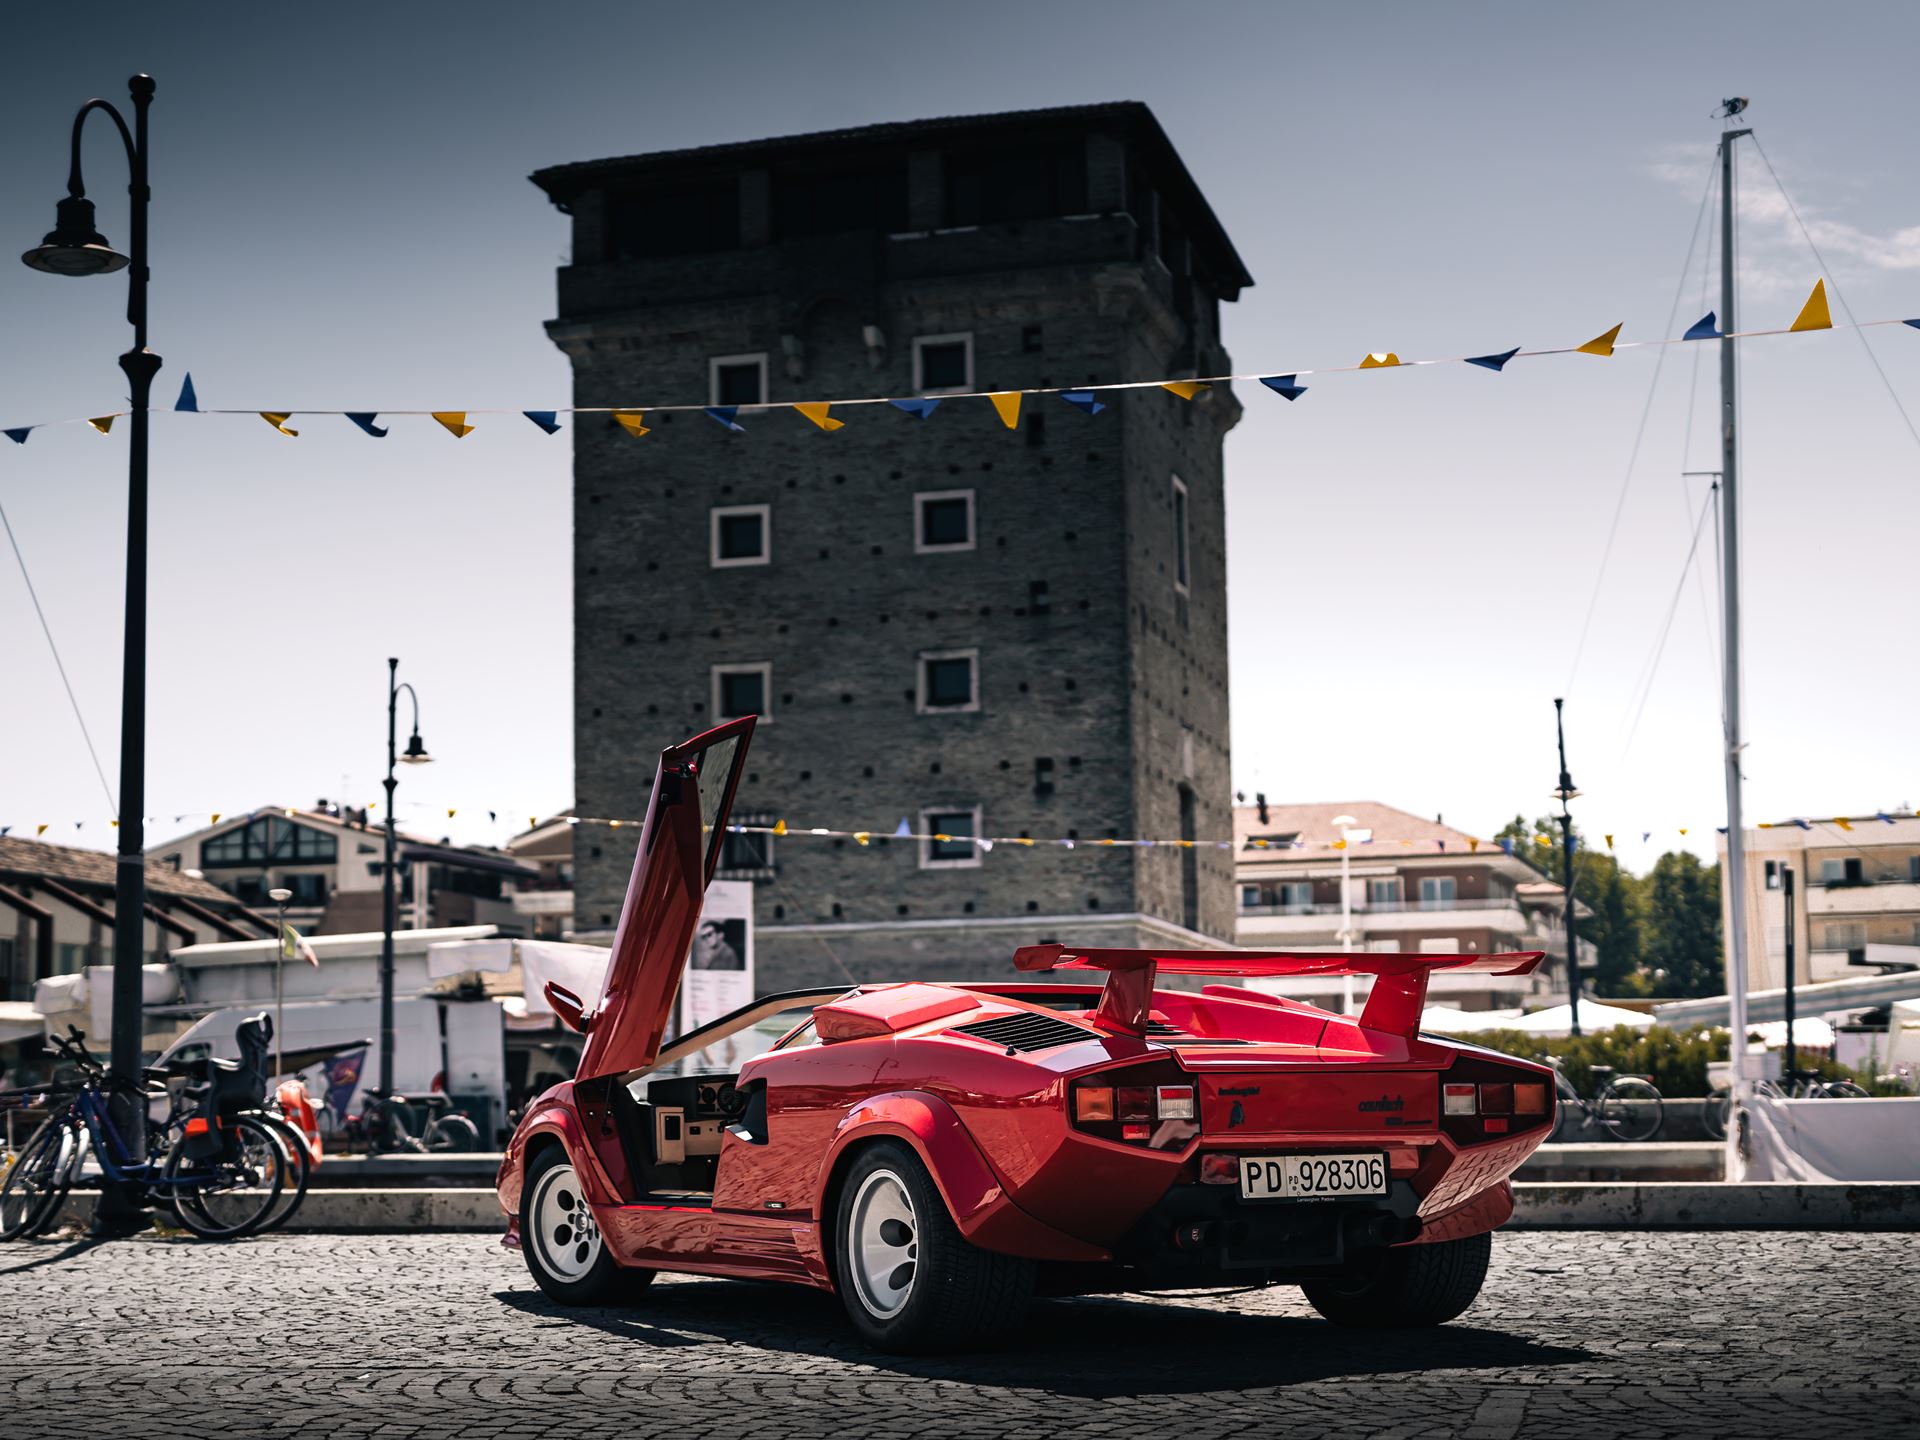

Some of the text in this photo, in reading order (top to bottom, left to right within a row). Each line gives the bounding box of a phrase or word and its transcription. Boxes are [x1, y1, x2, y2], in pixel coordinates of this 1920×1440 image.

[1246, 1158, 1384, 1193] PD 928306
[1288, 1175, 1299, 1185] PD
